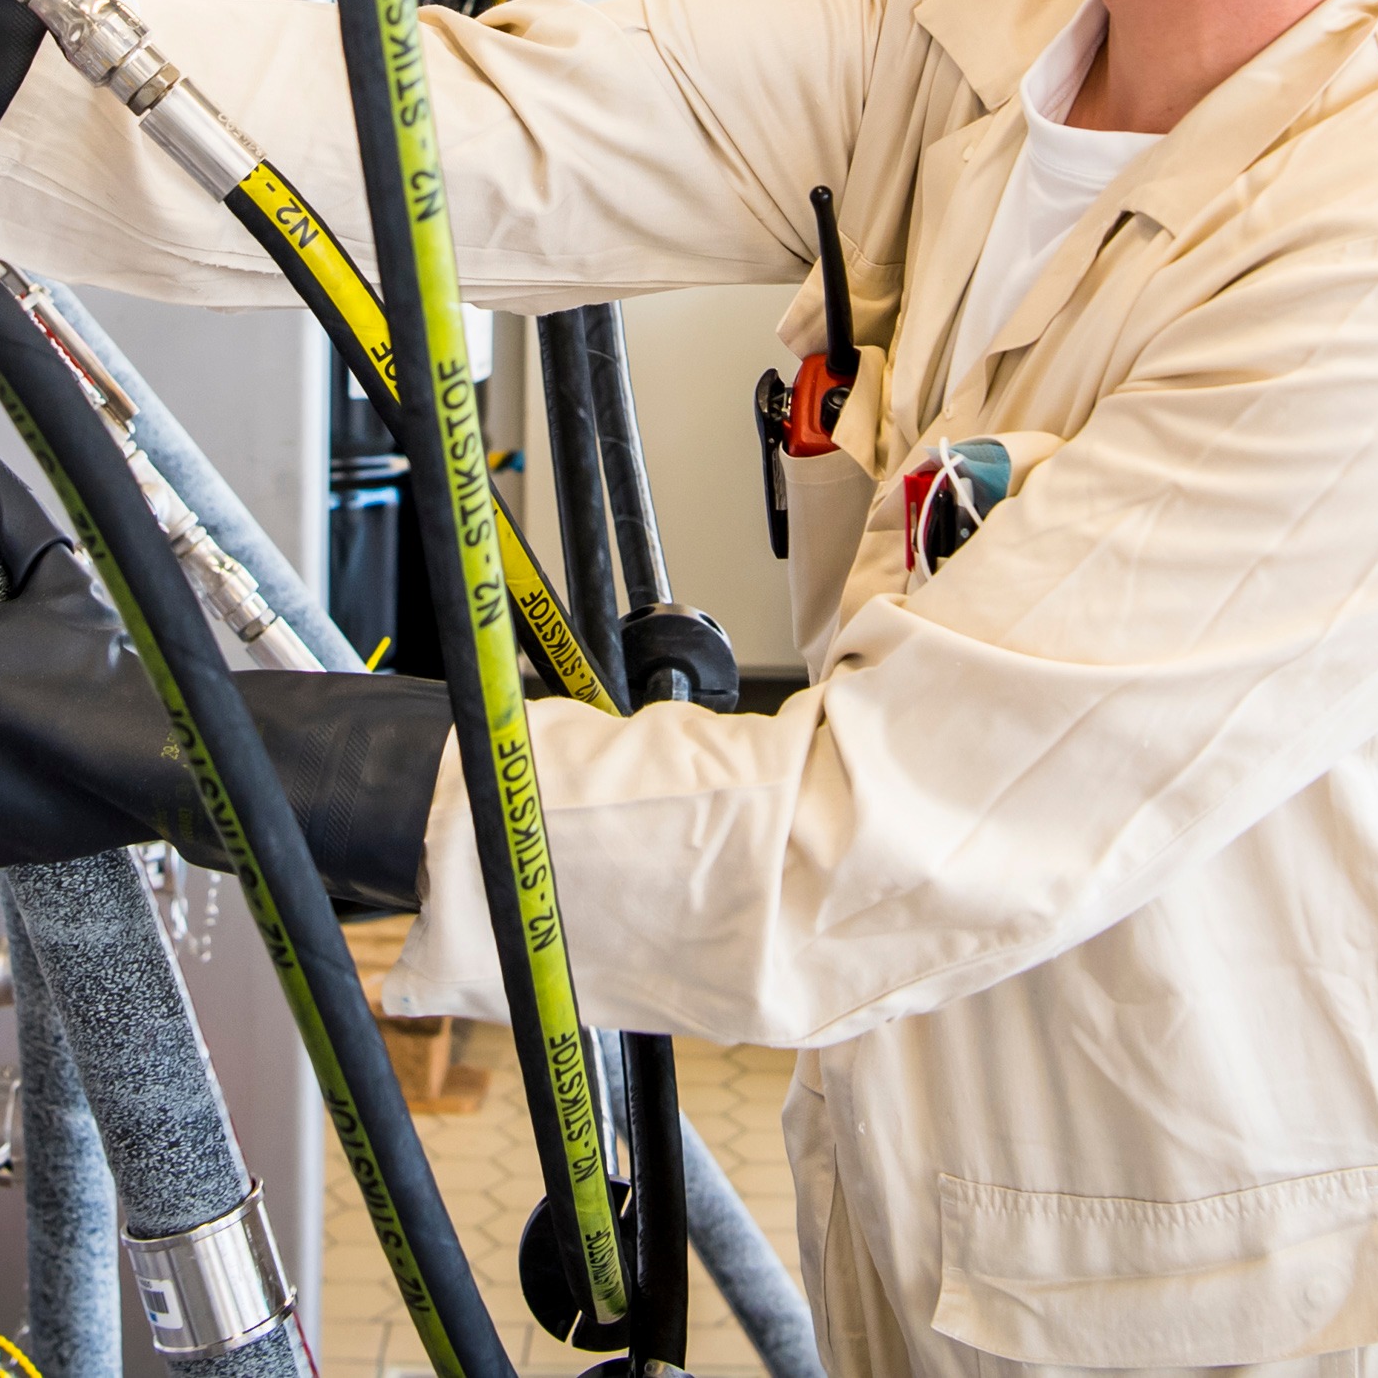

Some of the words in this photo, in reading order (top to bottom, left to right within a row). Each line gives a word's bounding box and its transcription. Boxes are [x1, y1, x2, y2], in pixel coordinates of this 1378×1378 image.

[276, 197, 320, 250] N2
[410, 169, 445, 223] N2
[438, 358, 493, 548] STIKSTOF
[474, 572, 505, 629] N2
[519, 589, 582, 677] STIKSTOF
[575, 677, 601, 702] N2
[498, 739, 548, 891] STIKSTOF
[529, 913, 558, 953] N2
[548, 1031, 593, 1142] STIKSTOF
[573, 1147, 599, 1184] N2
